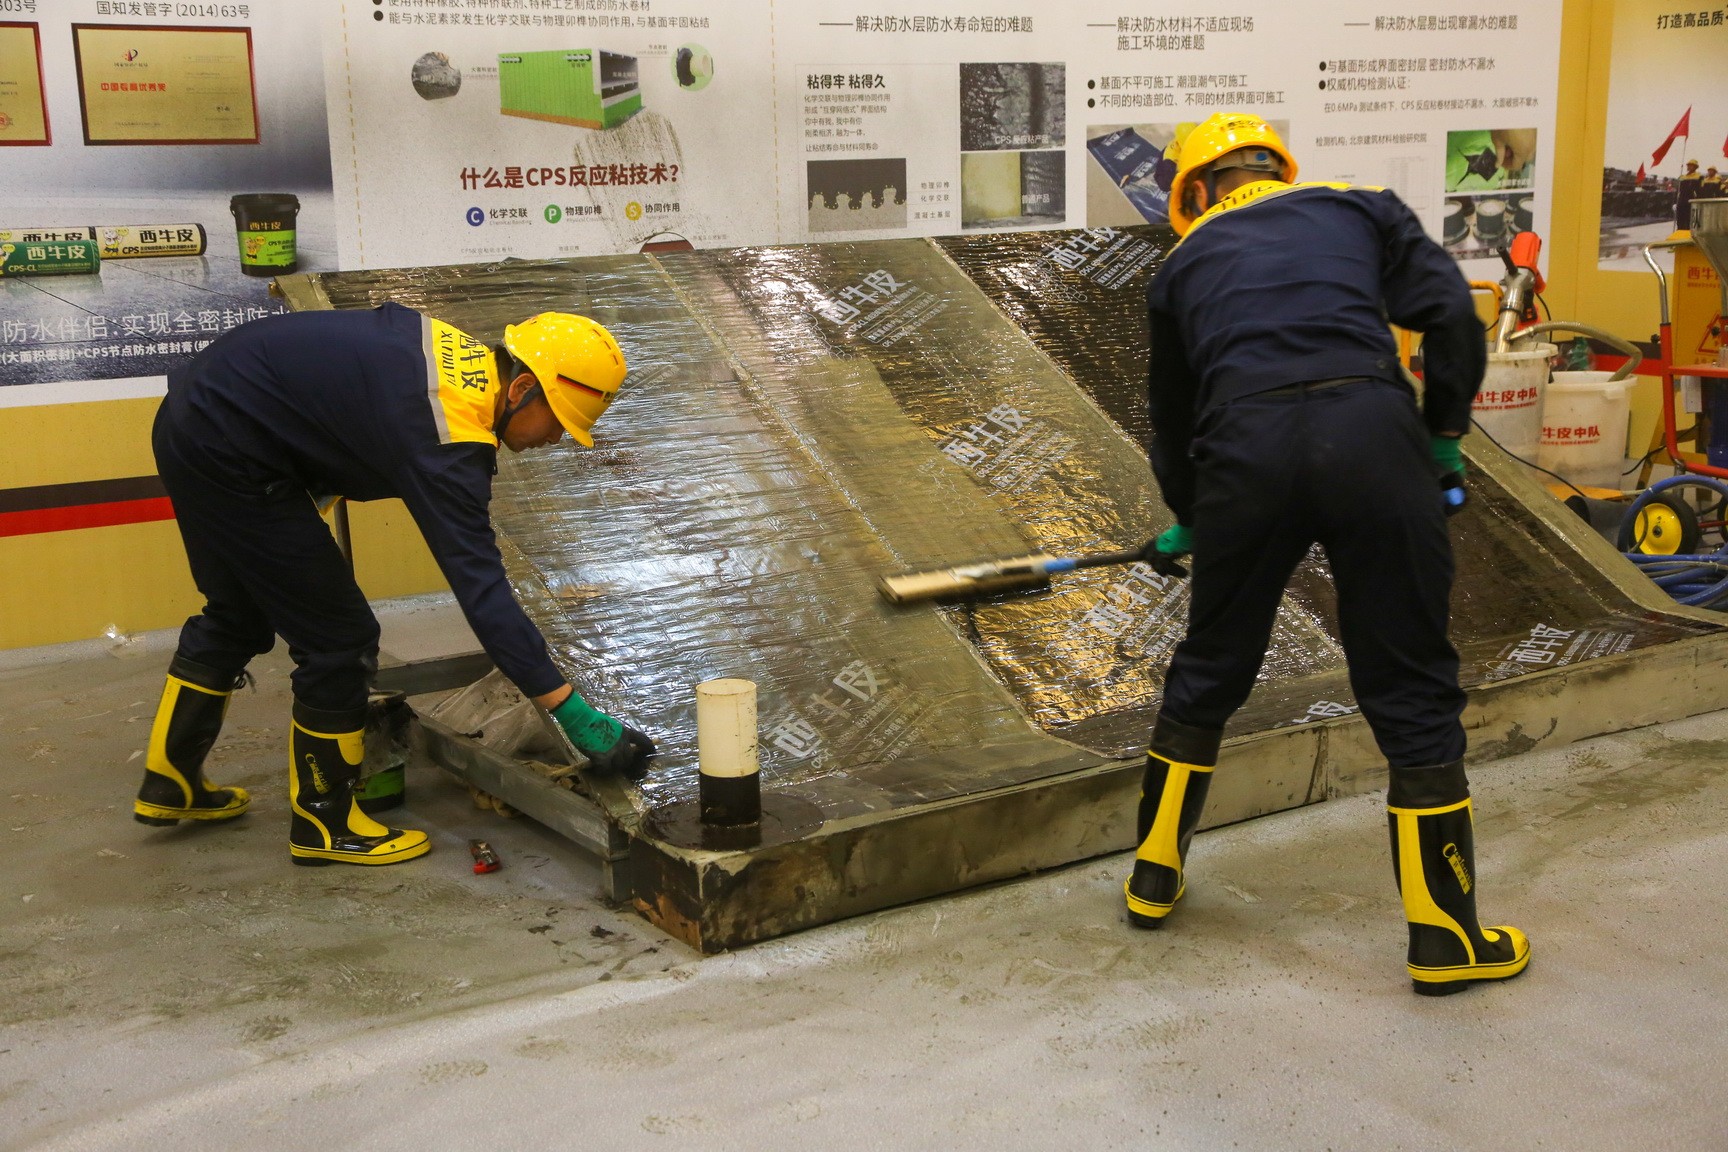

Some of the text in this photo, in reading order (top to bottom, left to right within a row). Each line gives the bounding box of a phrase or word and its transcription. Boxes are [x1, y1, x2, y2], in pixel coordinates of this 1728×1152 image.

[1657, 10, 1728, 29] 打造高品质
[1117, 34, 1205, 50] 施工环境的难题
[806, 73, 886, 89] 粘得牢 粘得久
[489, 208, 528, 219] 化学交联
[645, 203, 680, 213] 协同作用
[139, 229, 194, 243] 西牛皮
[26, 244, 87, 260] 西牛皮
[122, 246, 140, 254] CPS
[8, 264, 38, 273] CPS-CL
[1688, 266, 1719, 280] 西牛
[1507, 622, 1575, 664] 西牛皮
[764, 659, 890, 759] 西牛皮
